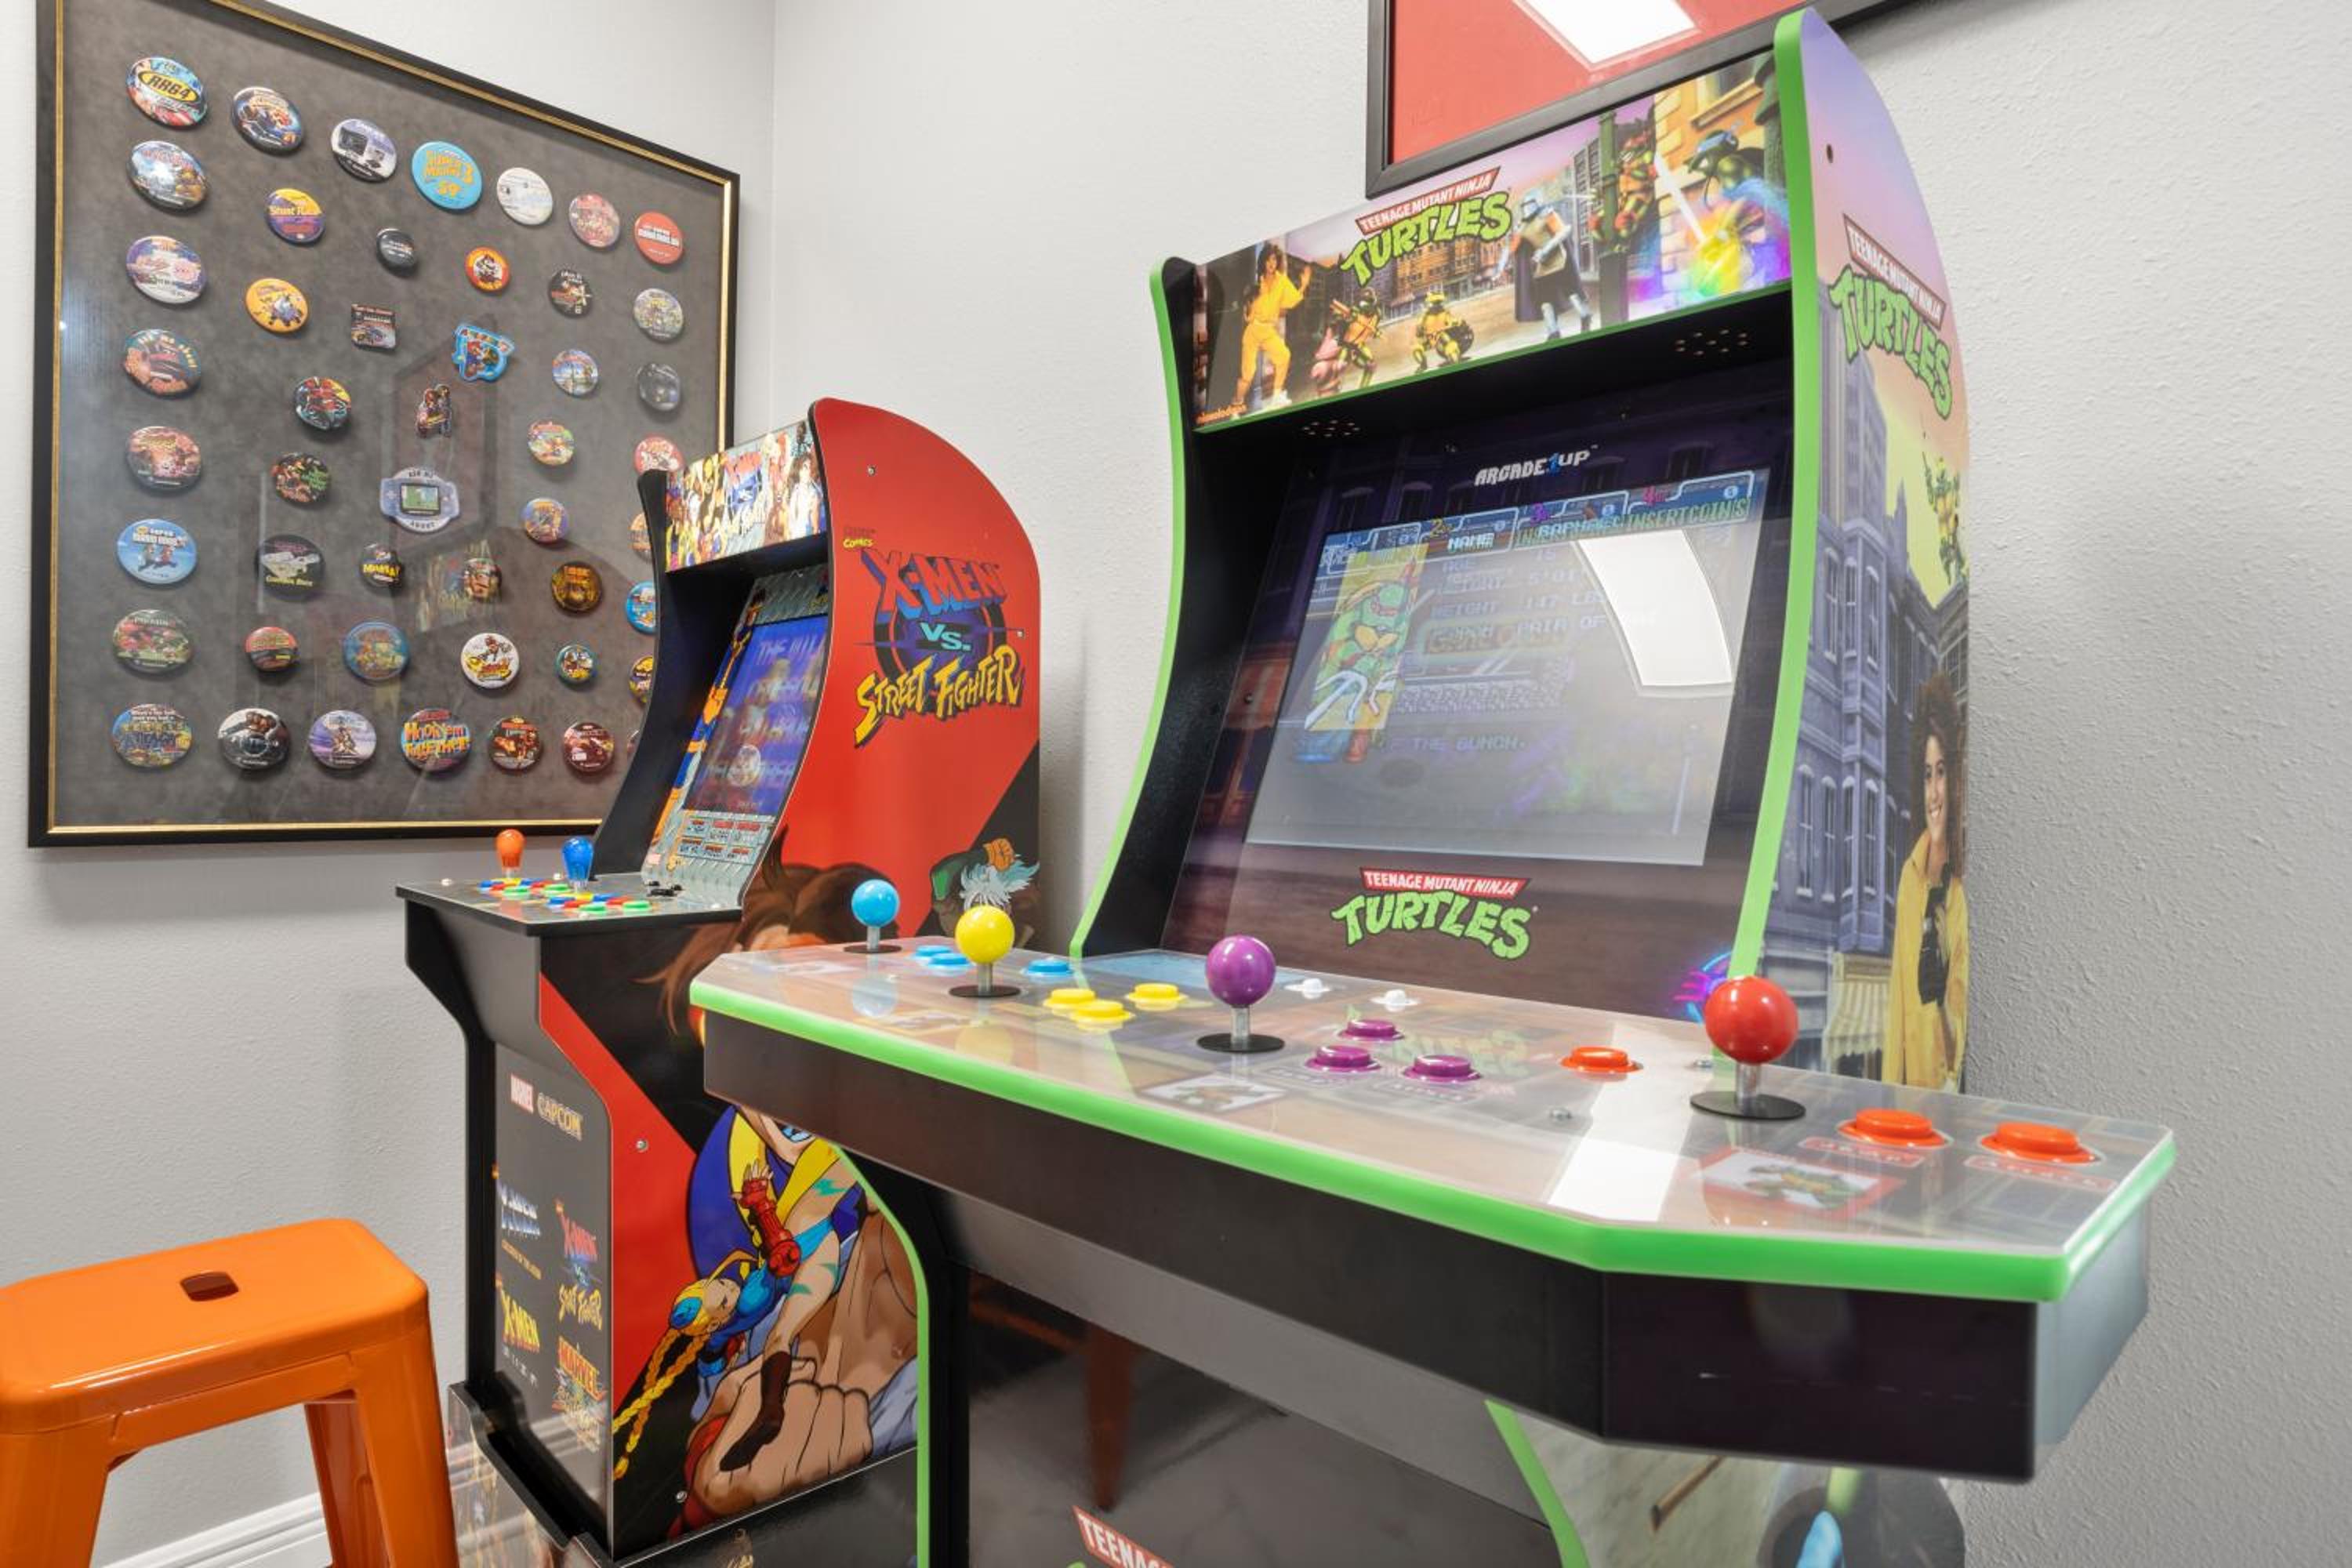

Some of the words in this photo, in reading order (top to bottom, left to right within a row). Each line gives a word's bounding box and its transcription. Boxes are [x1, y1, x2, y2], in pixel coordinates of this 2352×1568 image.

[1362, 203, 1411, 230] TEENAGE
[1412, 189, 1454, 214] MUTANT
[1455, 173, 1492, 197] NINJA
[1341, 191, 1512, 288] TURTLES
[1828, 263, 1953, 420] TURTLES
[1447, 532, 1494, 553] NAME
[861, 549, 1007, 620] X-MEN
[920, 622, 972, 652] VS.
[853, 655, 935, 747] STREET
[933, 644, 1022, 720] FIGHTER
[1364, 871, 1423, 889] TEENAGE
[1424, 875, 1475, 892] MUTANT
[1475, 879, 1519, 896] NINJA
[1330, 890, 1532, 960] TURTLES
[537, 1091, 583, 1142] CAPCOM
[1077, 1513, 1168, 1568] TEENA
